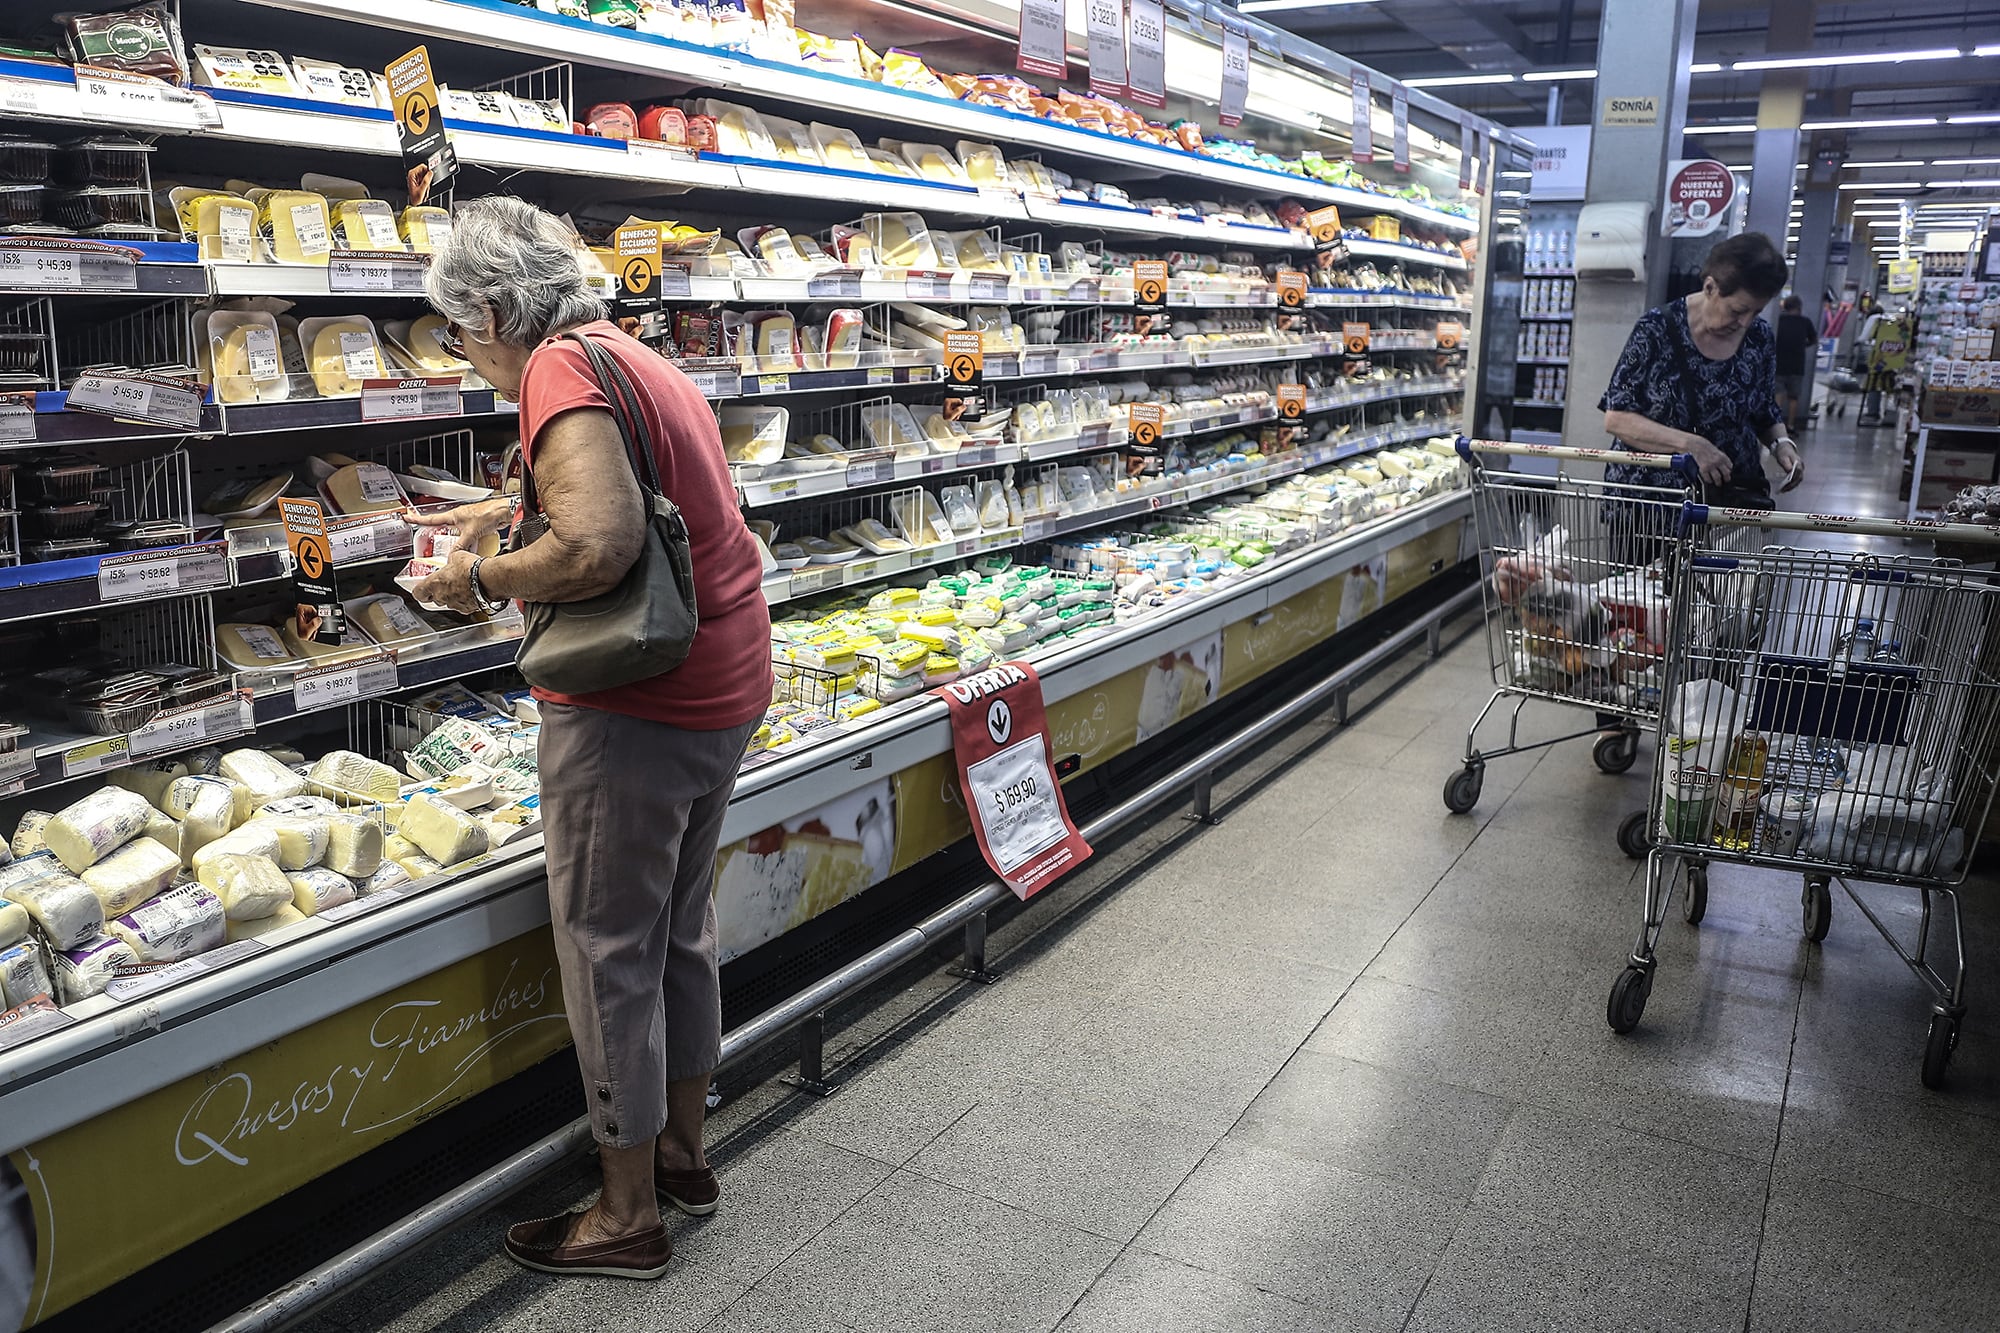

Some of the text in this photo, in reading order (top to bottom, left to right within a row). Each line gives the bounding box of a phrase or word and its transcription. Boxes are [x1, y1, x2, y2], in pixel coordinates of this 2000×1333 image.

[1092, 6, 1098, 22] $
[1134, 19, 1140, 35] $
[216, 56, 242, 64] PUNTA
[389, 52, 424, 79] BENEFICIO
[77, 67, 146, 85] BENEFICIO EXCLUSIVO
[309, 75, 334, 84] PUNTA
[392, 64, 426, 89] EXCLUSIVO
[89, 83, 107, 95] 15%
[394, 74, 429, 98] COMUNIDAD
[1611, 98, 1654, 112] SONRÍA
[1680, 181, 1724, 189] NUESTRAS
[1680, 189, 1723, 199] OFERTAS
[619, 228, 658, 240] BENEFICIO
[29, 240, 69, 249] EXCLUSIVO
[70, 243, 115, 253] COMUNIDAD
[619, 238, 658, 248] EXCLUSIVO
[357, 251, 385, 259] EXCLUSIVO
[384, 252, 416, 260] COMUNIDAD
[619, 247, 657, 256] COMUNIDAD
[2, 253, 72, 271] 15% $ 45,39
[338, 263, 388, 279] 15% $ 193,72
[947, 333, 979, 341] BENEFICIO
[947, 340, 979, 348] EXCLUSIVO
[146, 374, 184, 387] COMUNIDAD
[399, 379, 428, 388] OFERTA
[84, 379, 144, 401] 15% $ 45,39
[390, 394, 418, 405] $ 243,90
[283, 503, 318, 515] BENEFICIO
[1723, 507, 1771, 517] COTO
[286, 513, 321, 526] EXCLUSIVO
[337, 518, 363, 530] EXCLUSIVO
[363, 513, 391, 524] COMUNIDAD
[1807, 513, 1857, 522] COTO
[1894, 519, 1948, 528] COTO
[288, 524, 323, 536] COMUNIDAD
[343, 538, 349, 548] $
[349, 533, 369, 546] 172,47
[101, 546, 206, 566] BENEFICIO EXCLUSIVO COMUNIDAD
[110, 567, 170, 580] 15% $ 52,62
[296, 669, 321, 679] BENEFICIO
[321, 663, 350, 674] EXCLUSIVO
[350, 656, 380, 667] COMUNIDAD
[303, 677, 352, 692] 15% $ 193,72
[946, 664, 1027, 704] OFERTA
[165, 703, 197, 717] EXCLUSIVO
[197, 695, 230, 708] COMUNIDAD
[168, 722, 174, 731] $
[176, 717, 197, 730] 57,72
[995, 776, 1036, 815] $ 169,90
[137, 961, 175, 975] EXCLUSIVO
[174, 959, 553, 1166] Quesos y Fiambres
